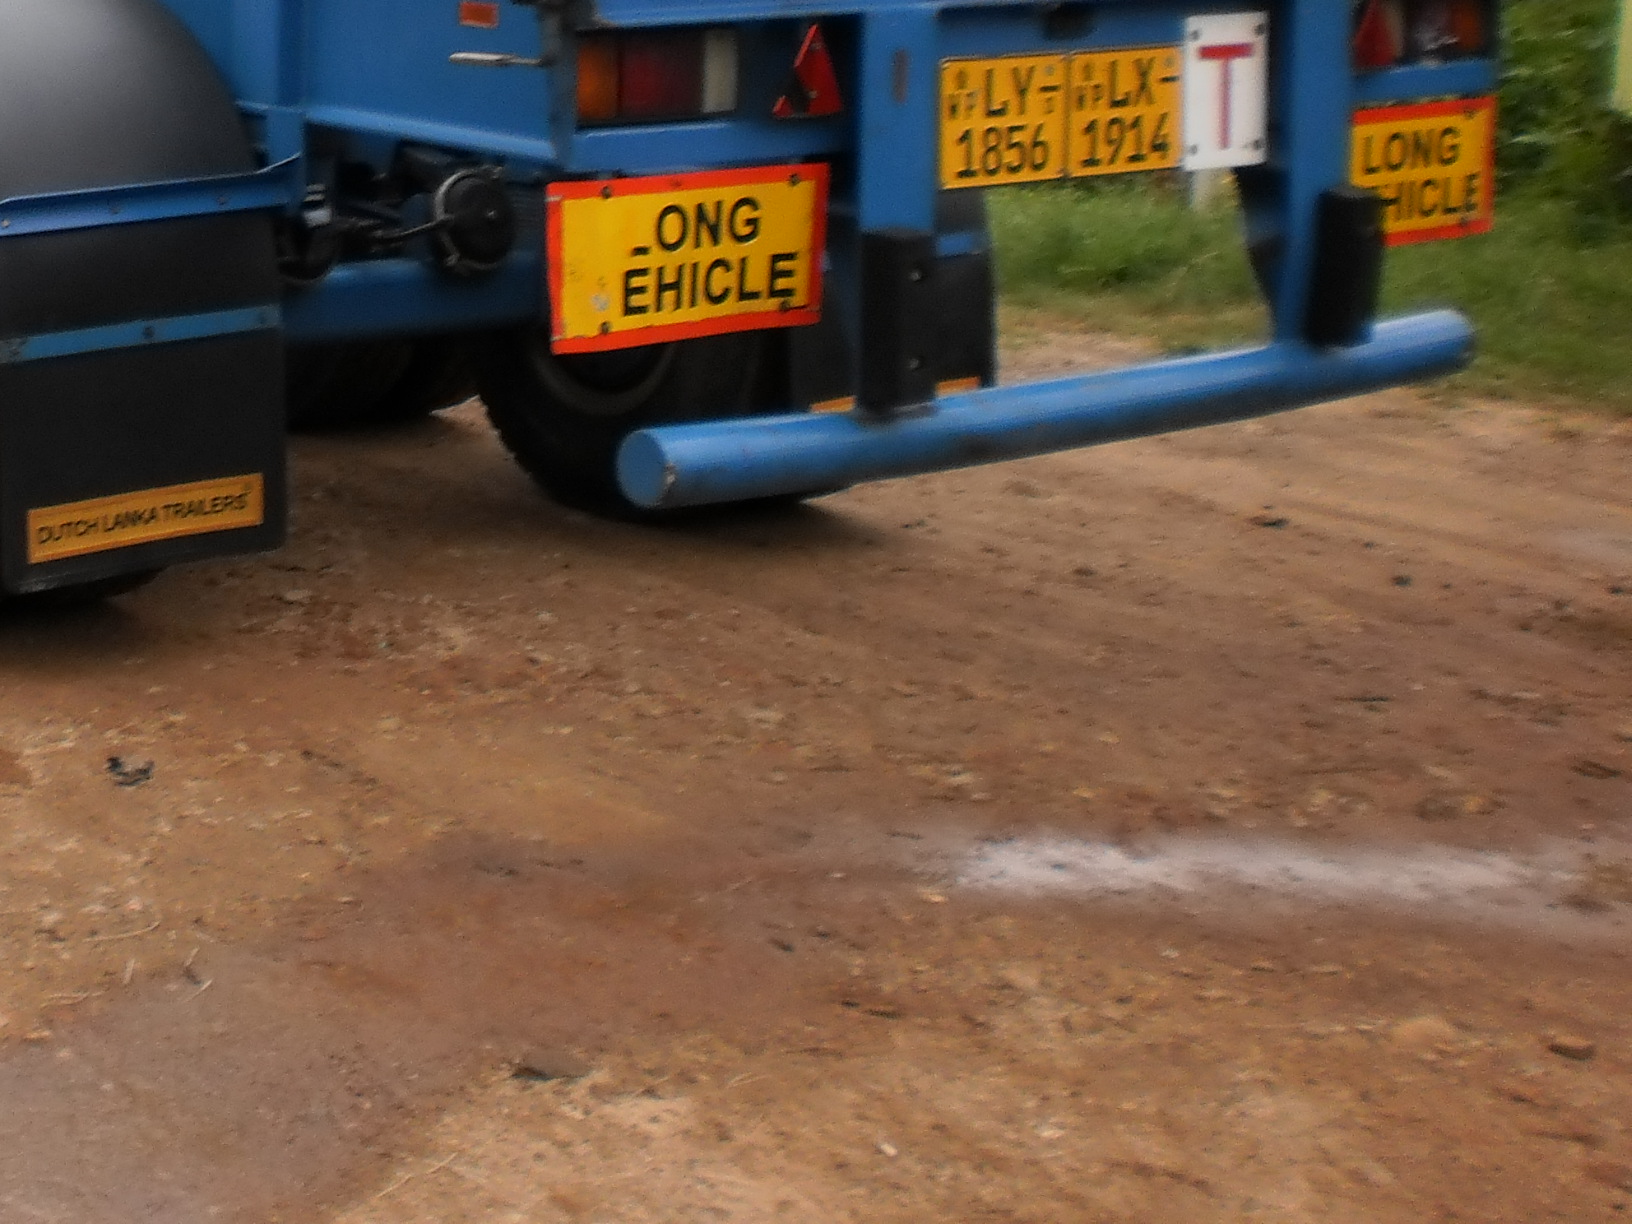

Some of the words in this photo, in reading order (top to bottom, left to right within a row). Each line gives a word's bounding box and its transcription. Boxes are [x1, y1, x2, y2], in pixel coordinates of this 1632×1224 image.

[1197, 42, 1256, 149] T
[955, 122, 1050, 178] 1856
[1081, 113, 1170, 167] 1914
[1363, 126, 1461, 175] LONG
[1379, 171, 1481, 221] HICLE
[630, 197, 763, 257] ONG
[37, 518, 100, 545] DUTCH
[103, 506, 160, 534] LANKA
[163, 491, 252, 520] TRAILERS
